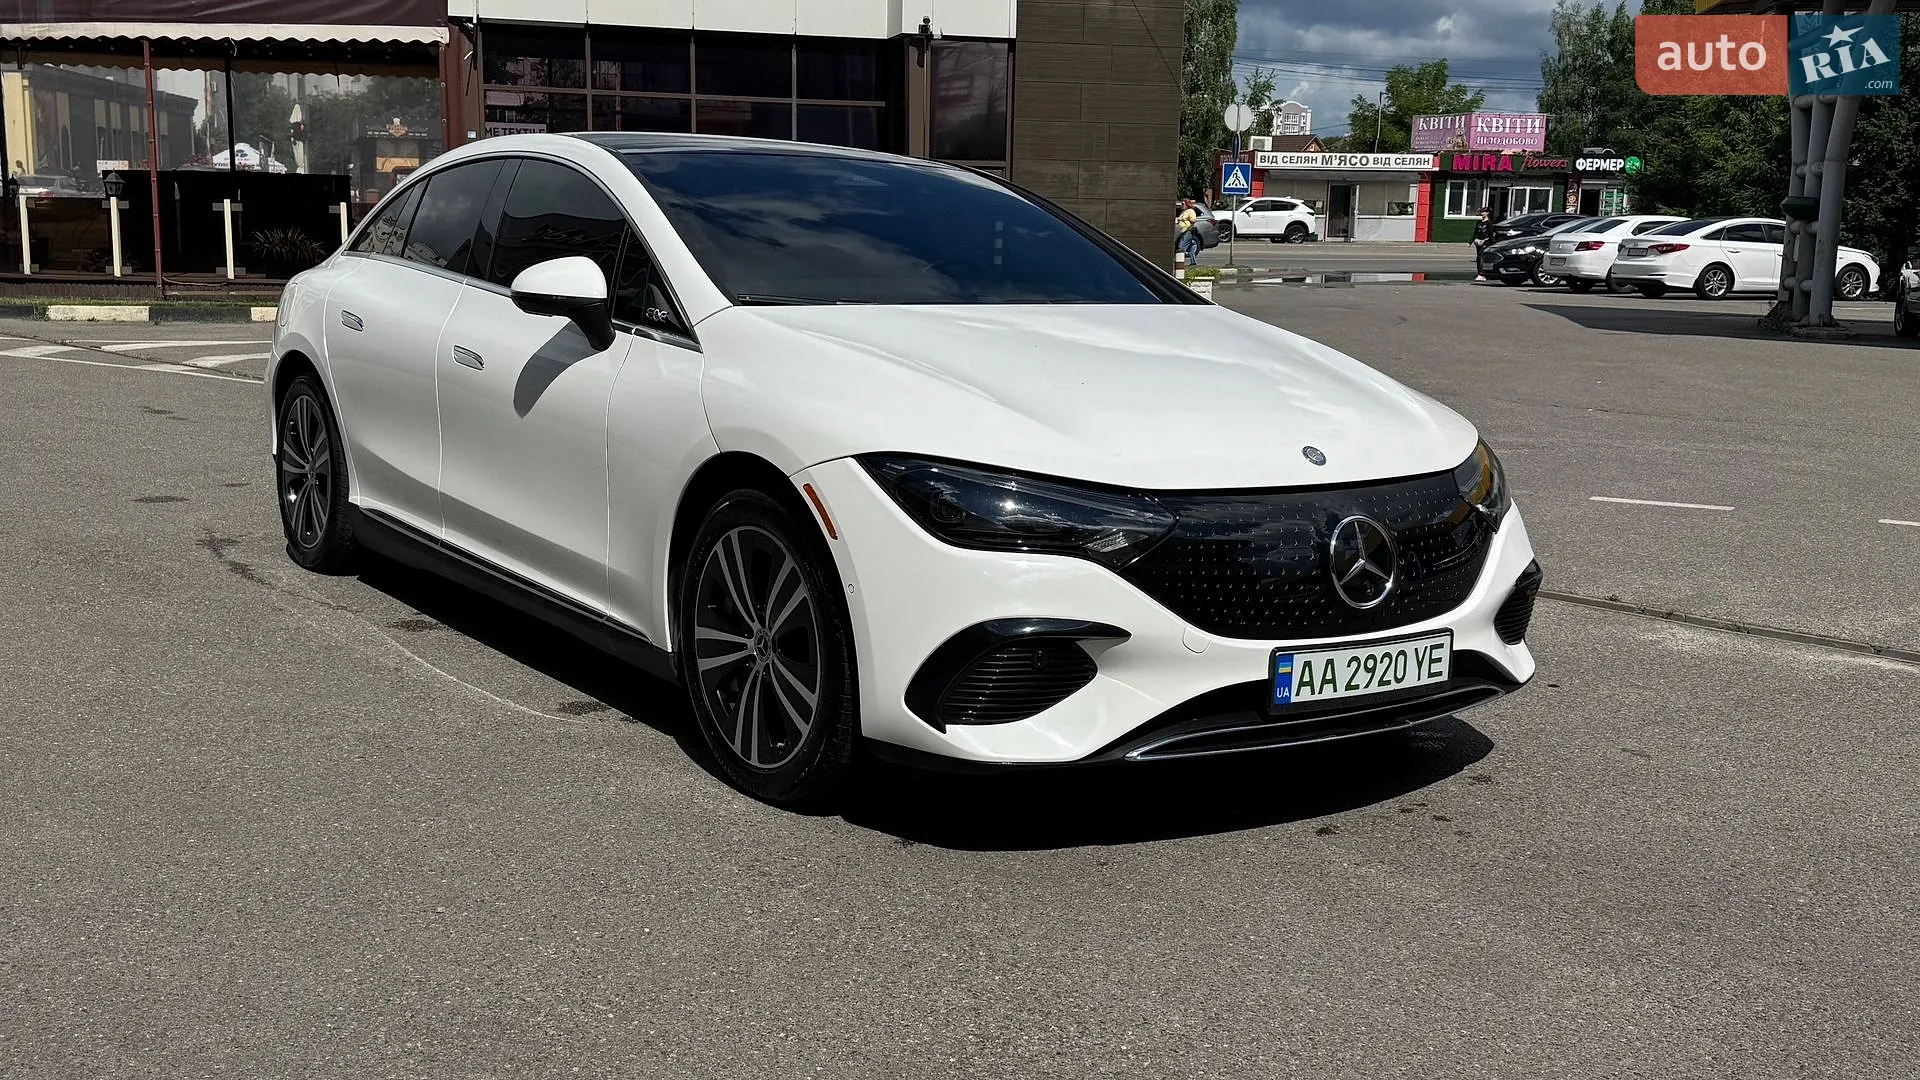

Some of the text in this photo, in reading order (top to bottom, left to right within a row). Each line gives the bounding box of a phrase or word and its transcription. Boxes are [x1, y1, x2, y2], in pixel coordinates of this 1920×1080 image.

[1418, 115, 1465, 130] КВІТИ
[1476, 117, 1541, 134] КВІТИ
[1476, 137, 1538, 146] ЦІЛОДОБОВО
[1259, 155, 1278, 165] ВІД
[1281, 155, 1318, 165] СЕЛЯН
[1372, 157, 1391, 166] ВІД
[1394, 157, 1431, 166] СЕЛЯН
[1453, 154, 1569, 172] MIRA flowers
[1575, 158, 1625, 171] ФЕРМЕР
[1295, 642, 1445, 697] AA 2920 YE
[1276, 687, 1290, 698] UA
